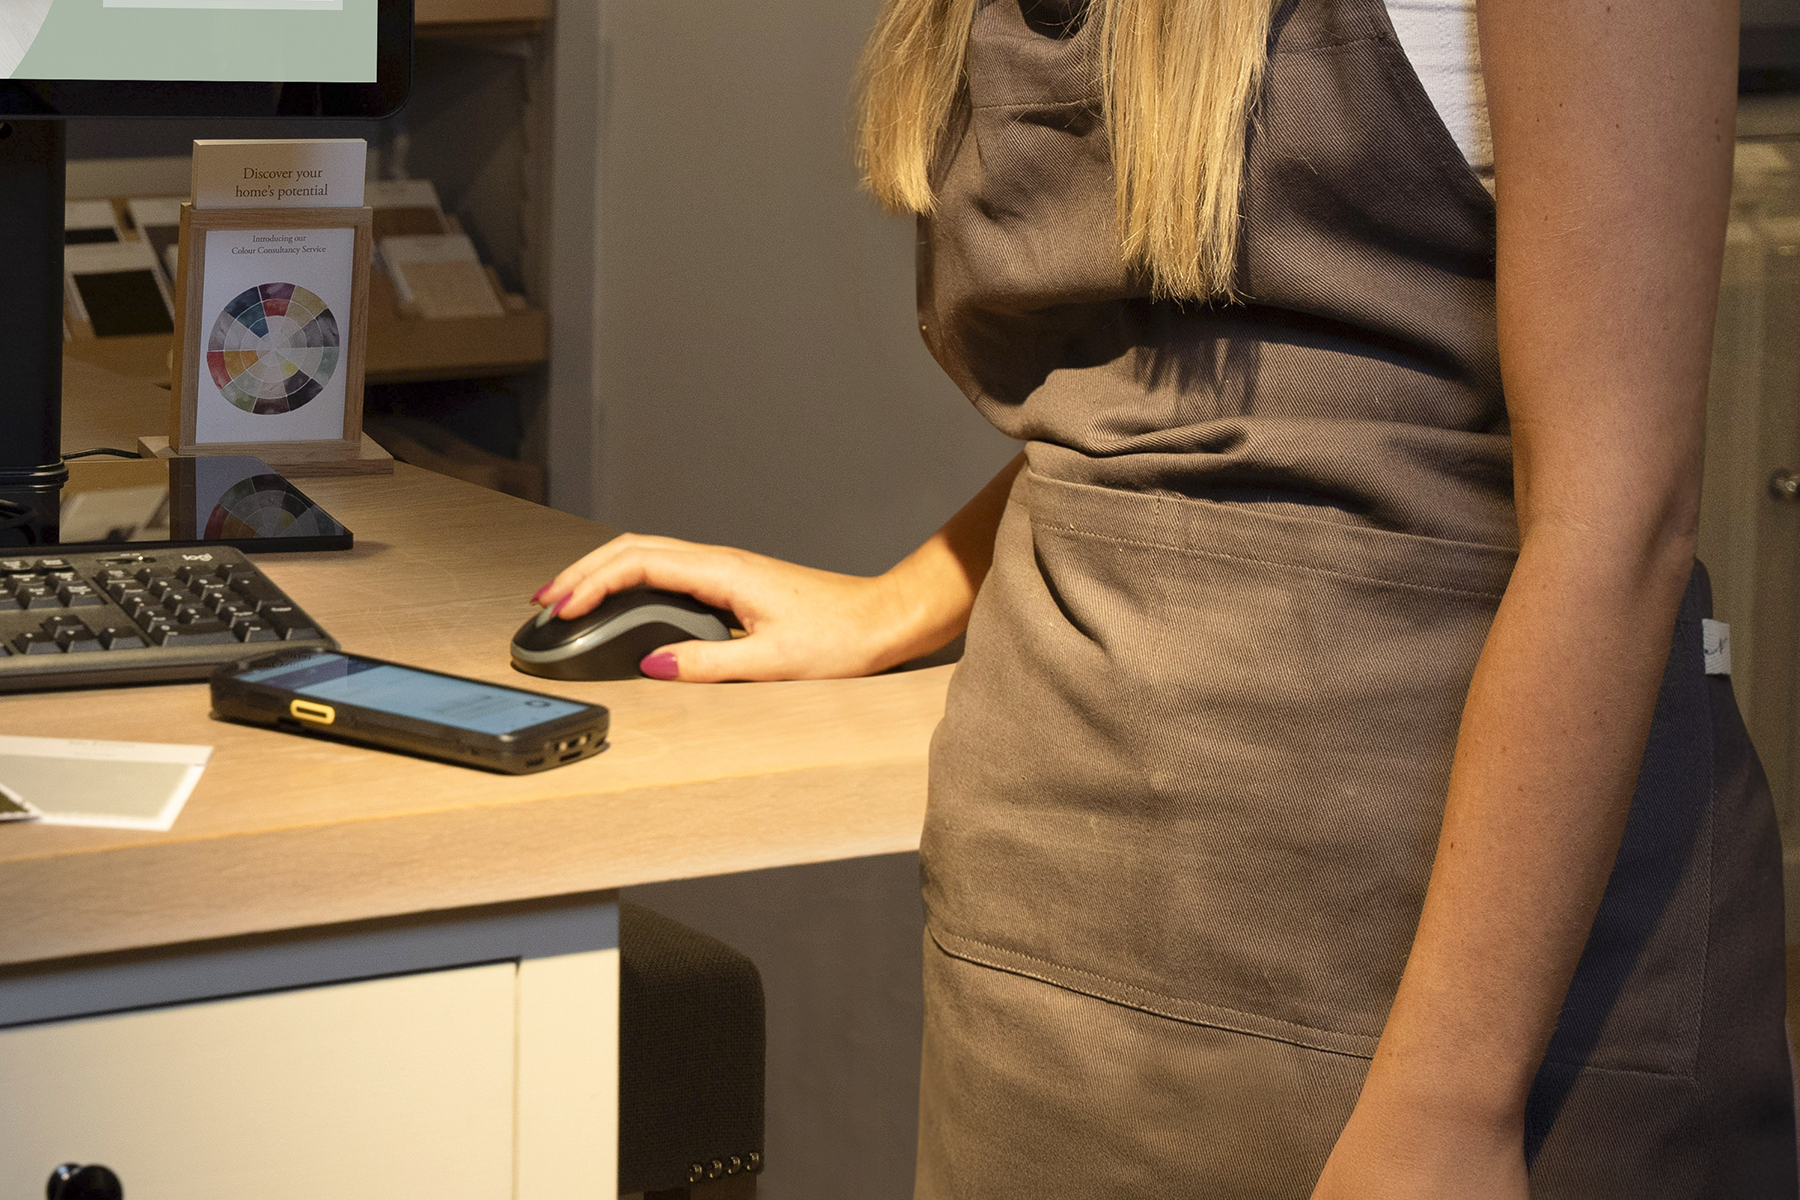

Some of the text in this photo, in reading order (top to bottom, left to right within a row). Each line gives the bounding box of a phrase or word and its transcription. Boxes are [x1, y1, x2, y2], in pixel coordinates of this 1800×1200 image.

[243, 167, 323, 182] Discover your
[277, 183, 328, 201] potential
[252, 234, 293, 244] Introducing
[231, 245, 327, 256] Colour Consultancy Service
